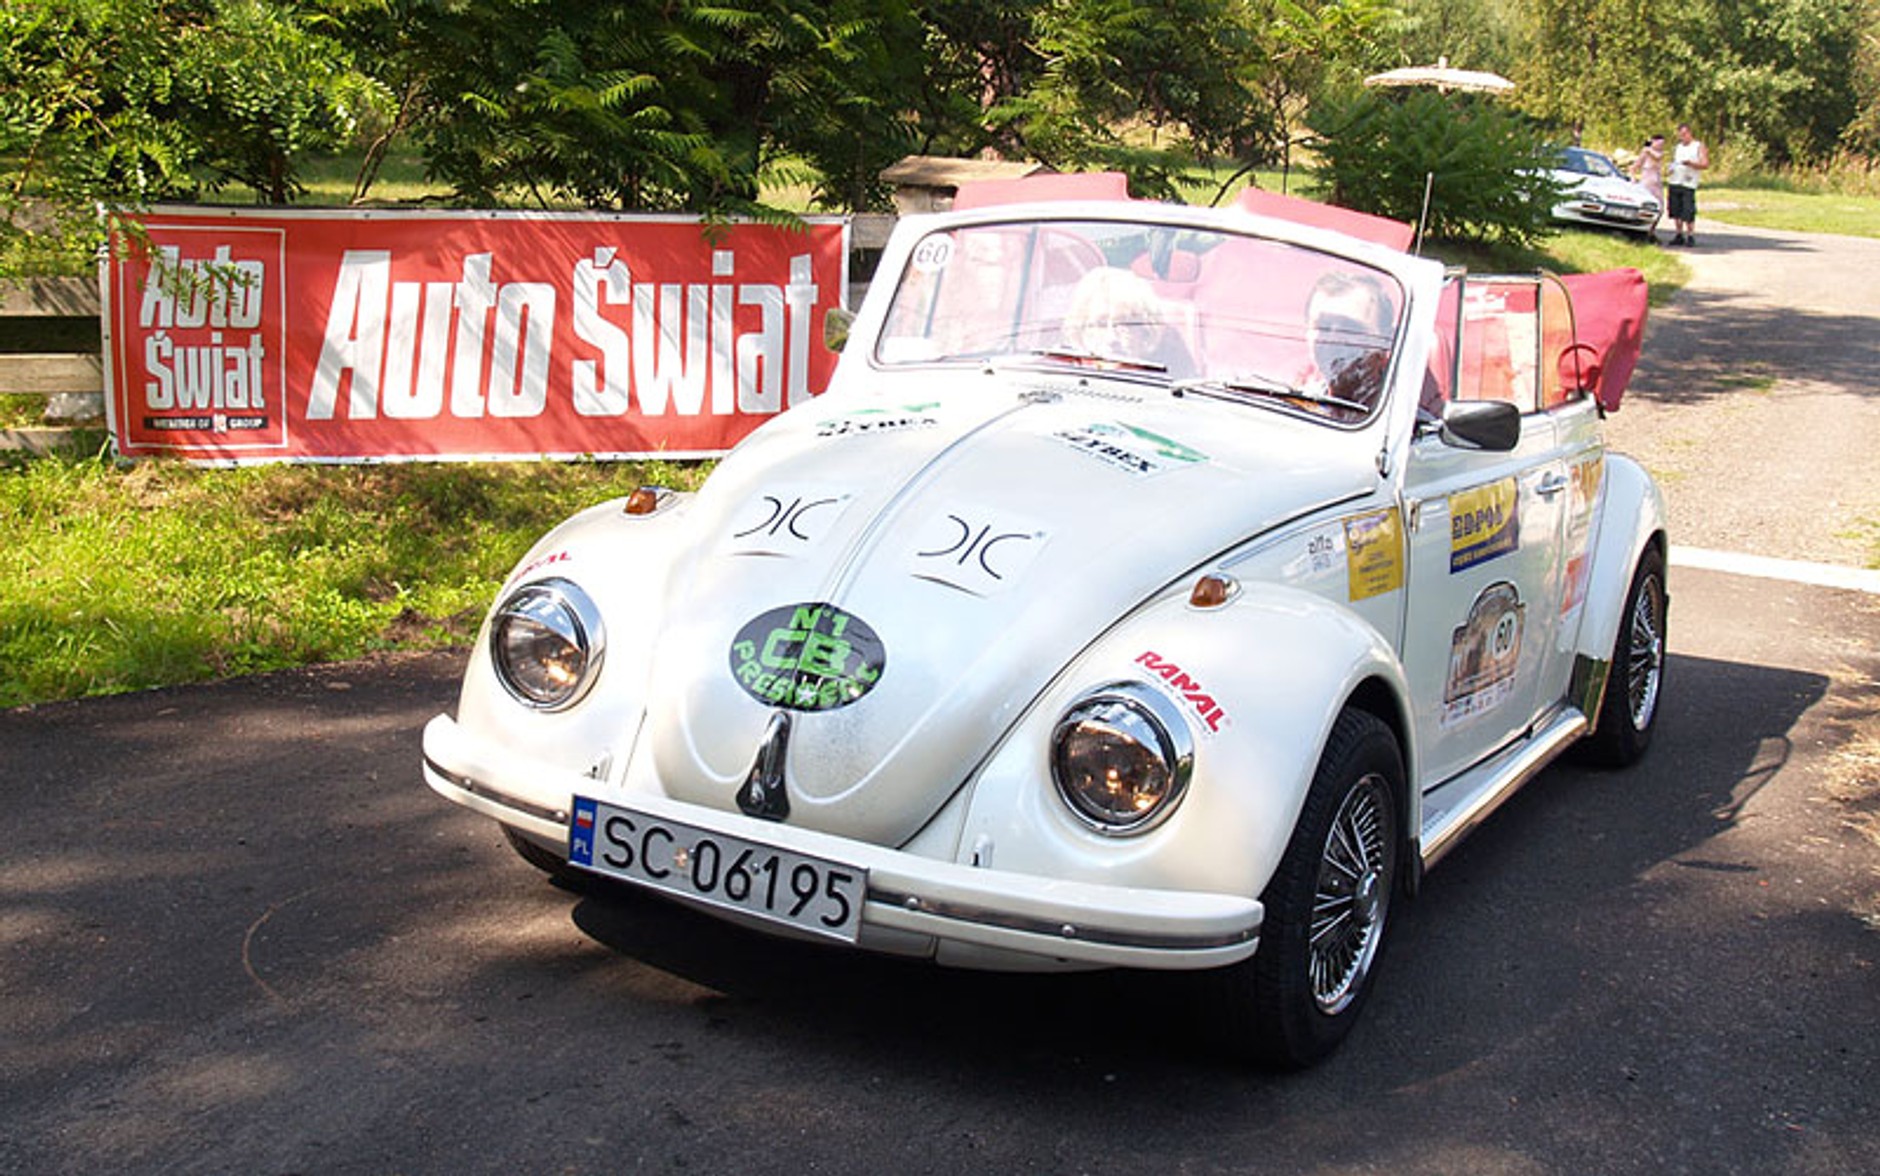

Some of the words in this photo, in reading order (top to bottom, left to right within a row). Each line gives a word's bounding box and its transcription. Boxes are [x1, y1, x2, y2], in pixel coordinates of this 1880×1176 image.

[139, 245, 265, 328] Auto
[145, 330, 265, 410] Świat
[306, 249, 556, 420] Auto
[571, 246, 818, 417] Świat
[760, 627, 851, 677] CB
[1134, 650, 1225, 733] RANAL
[572, 837, 590, 856] PL
[602, 816, 674, 879] SC
[691, 839, 853, 928] 06195
